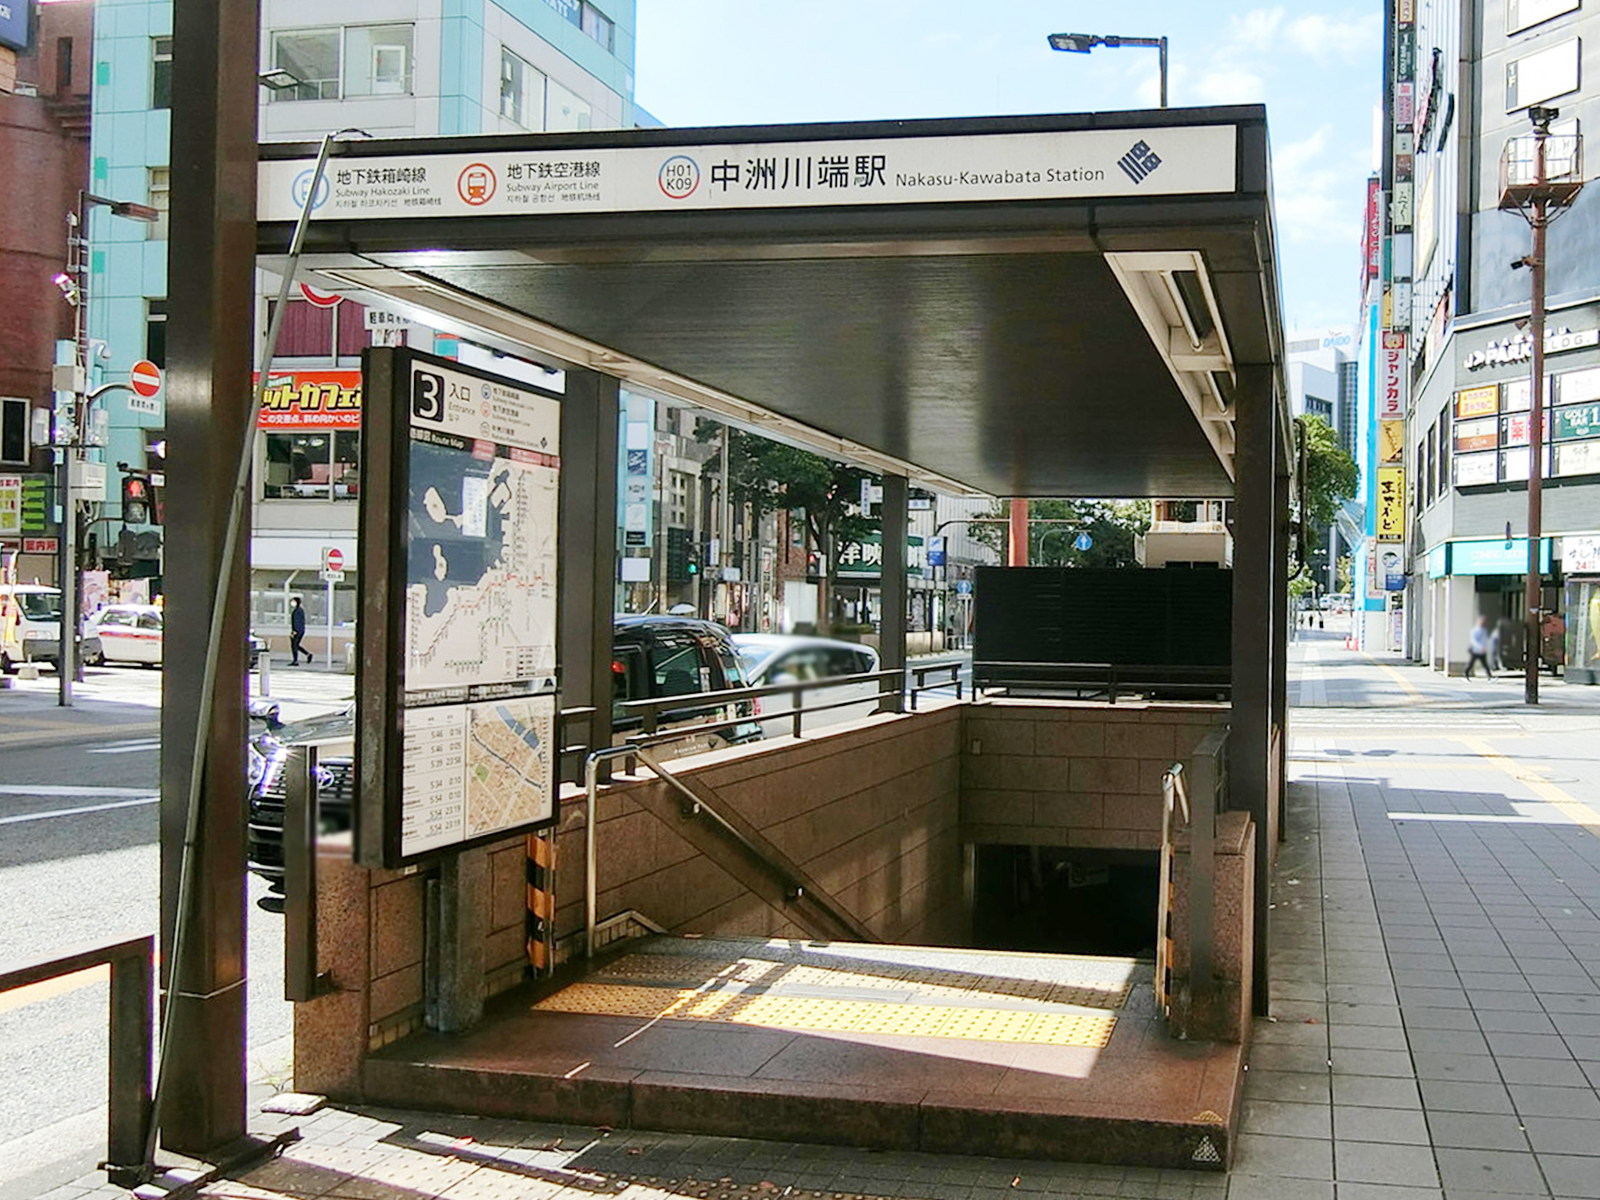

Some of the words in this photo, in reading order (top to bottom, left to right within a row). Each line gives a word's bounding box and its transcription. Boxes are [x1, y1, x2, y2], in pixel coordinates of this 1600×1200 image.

[336, 166, 427, 185] 地下鉄箱崎線
[507, 160, 601, 179] 地下鉄空港線
[666, 165, 692, 177] H01
[711, 155, 886, 191] 中洲川端駅
[895, 169, 1041, 187] Nakasu-Kawabata
[1046, 166, 1105, 183] Station
[335, 188, 369, 198] Subway
[371, 187, 410, 197] Hakozaki
[412, 186, 431, 195] Line
[506, 182, 541, 193] Subway
[544, 181, 577, 192] Airport
[579, 180, 600, 190] Line
[666, 178, 692, 190] K09
[1387, 350, 1399, 412] ジャンカラ
[419, 373, 439, 419] 3
[449, 382, 471, 402] 入口
[448, 401, 476, 416] Entrance
